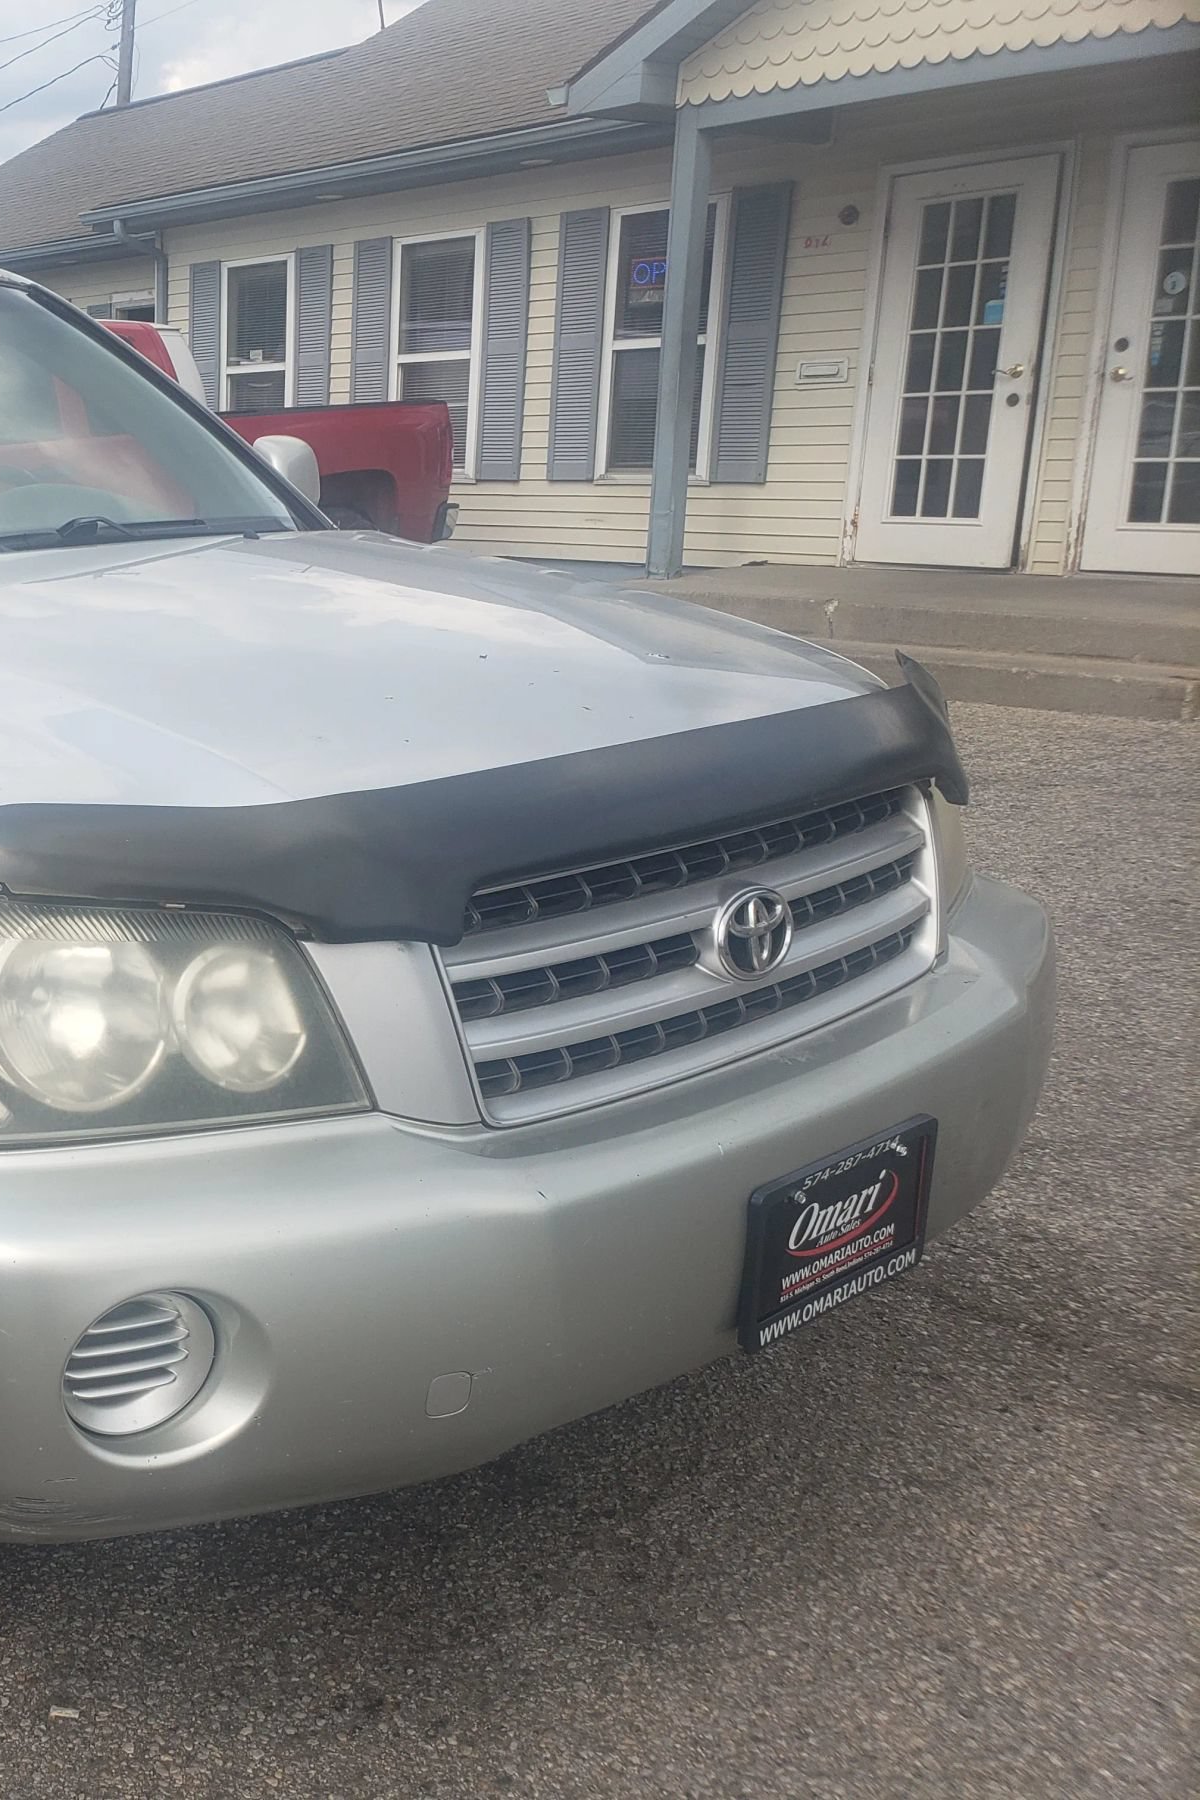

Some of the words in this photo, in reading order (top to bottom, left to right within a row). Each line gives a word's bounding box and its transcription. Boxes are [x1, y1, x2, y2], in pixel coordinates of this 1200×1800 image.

[633, 261, 667, 284] OP
[802, 1135, 900, 1190] 574-287-4714
[788, 1168, 886, 1250] Omari
[816, 1231, 839, 1248] Auto
[838, 1218, 862, 1236] Sales
[780, 1222, 895, 1291] WWW.OMARIAUTO.COM
[758, 1248, 916, 1347] WWW.OMARIAUTO.COM
